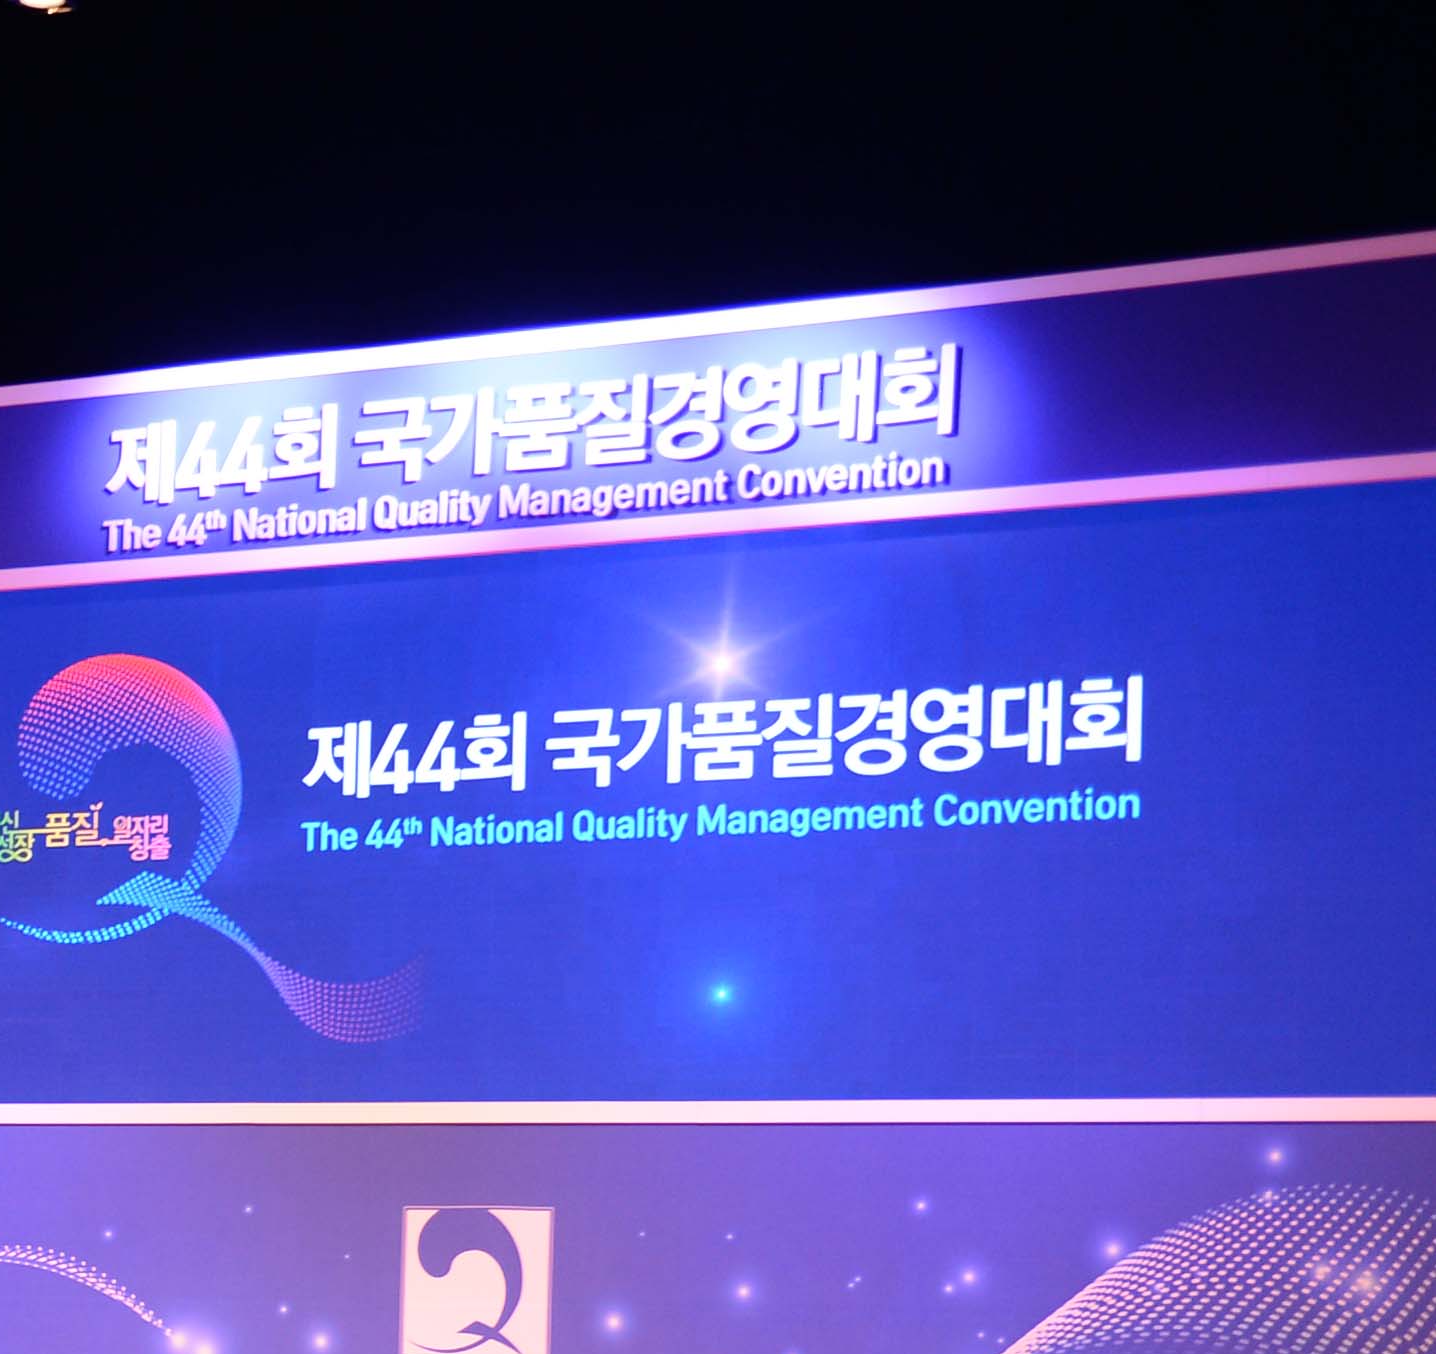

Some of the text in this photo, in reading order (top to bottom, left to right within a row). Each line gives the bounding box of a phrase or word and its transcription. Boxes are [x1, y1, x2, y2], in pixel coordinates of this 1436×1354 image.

[104, 343, 959, 504] 제44회 국가품질경영대회
[103, 450, 946, 553] The 44th National Quality Management Convention
[302, 675, 1143, 799] 제44회 국가품질경영대회
[45, 805, 101, 848] 품질
[301, 787, 1141, 852] The 44th National Quality Management Convention
